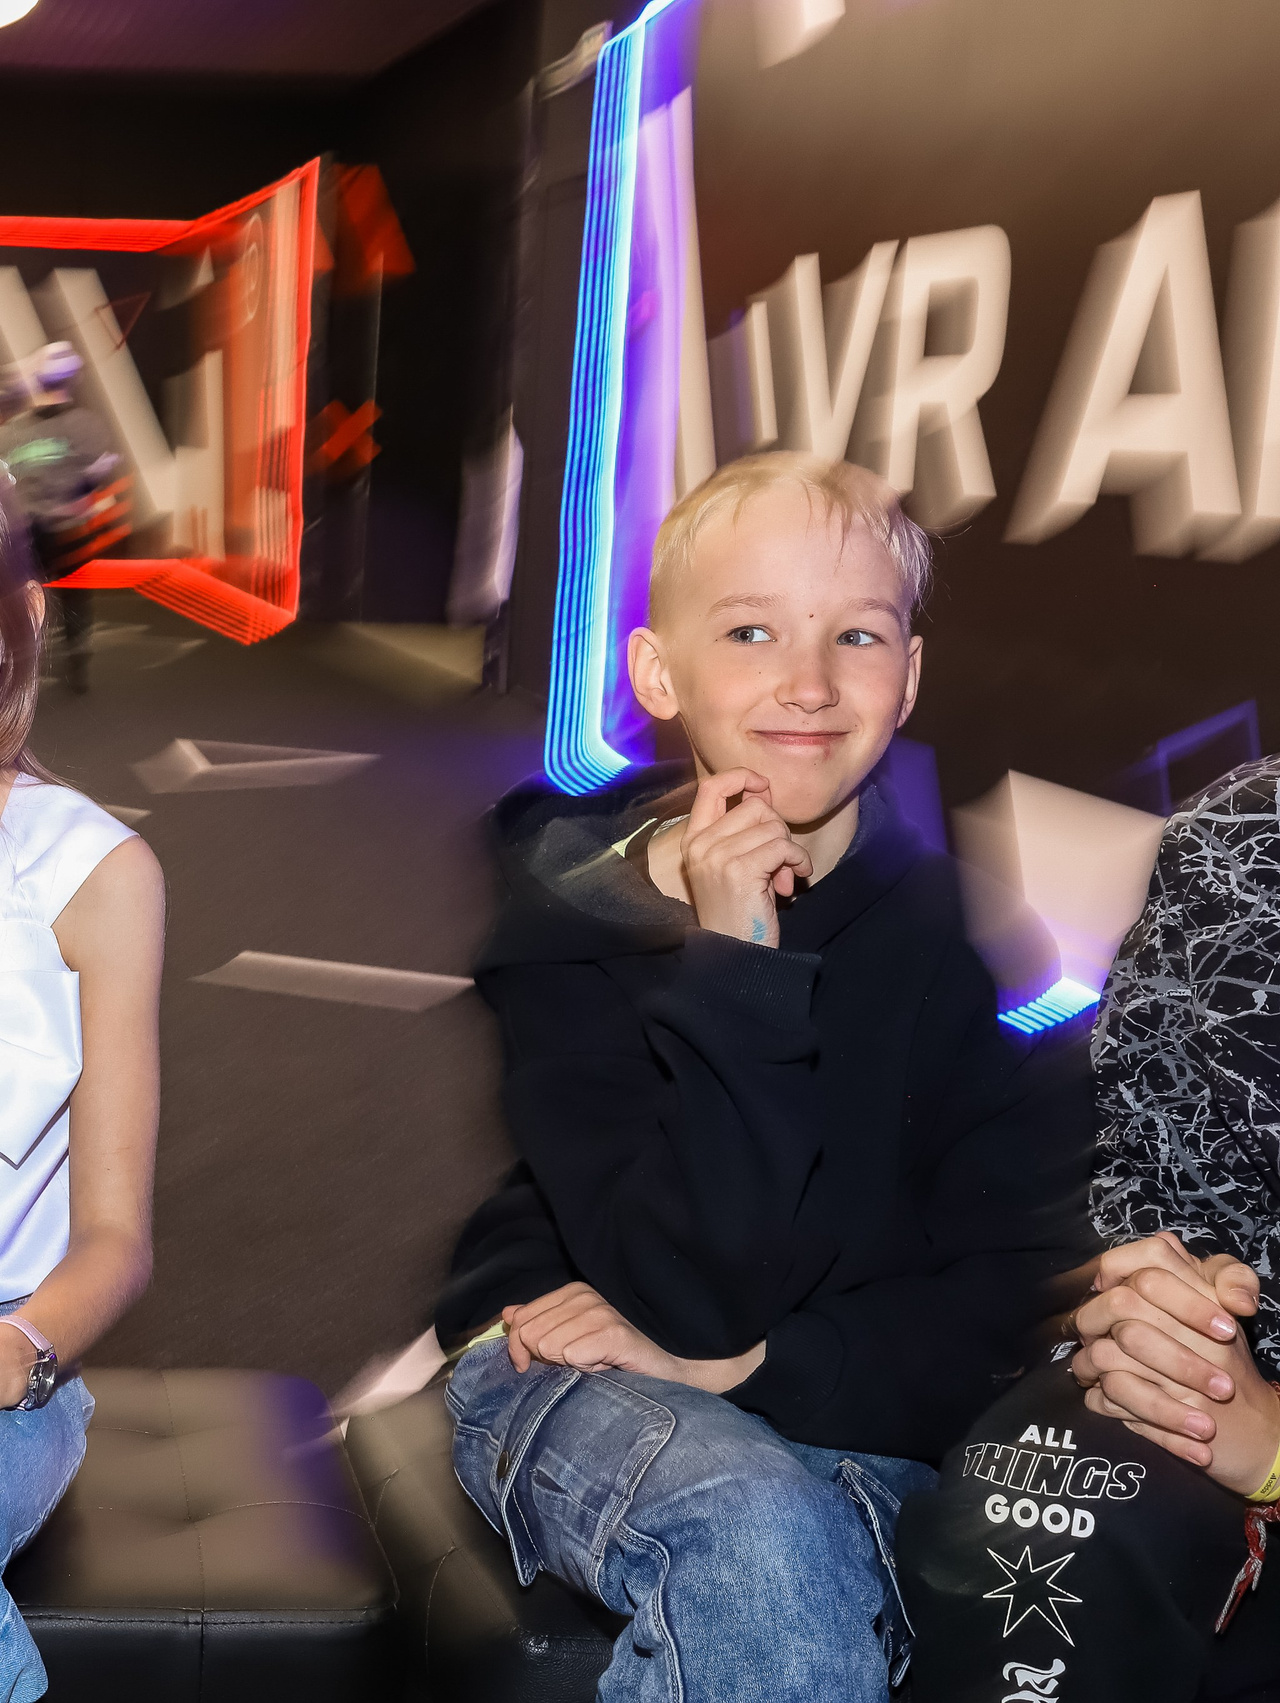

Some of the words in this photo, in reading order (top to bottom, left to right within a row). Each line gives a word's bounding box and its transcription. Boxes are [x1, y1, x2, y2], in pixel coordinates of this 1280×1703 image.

[1019, 1424, 1077, 1450] ALL
[962, 1443, 1147, 1500] THINGS
[984, 1494, 1096, 1538] GOOD
